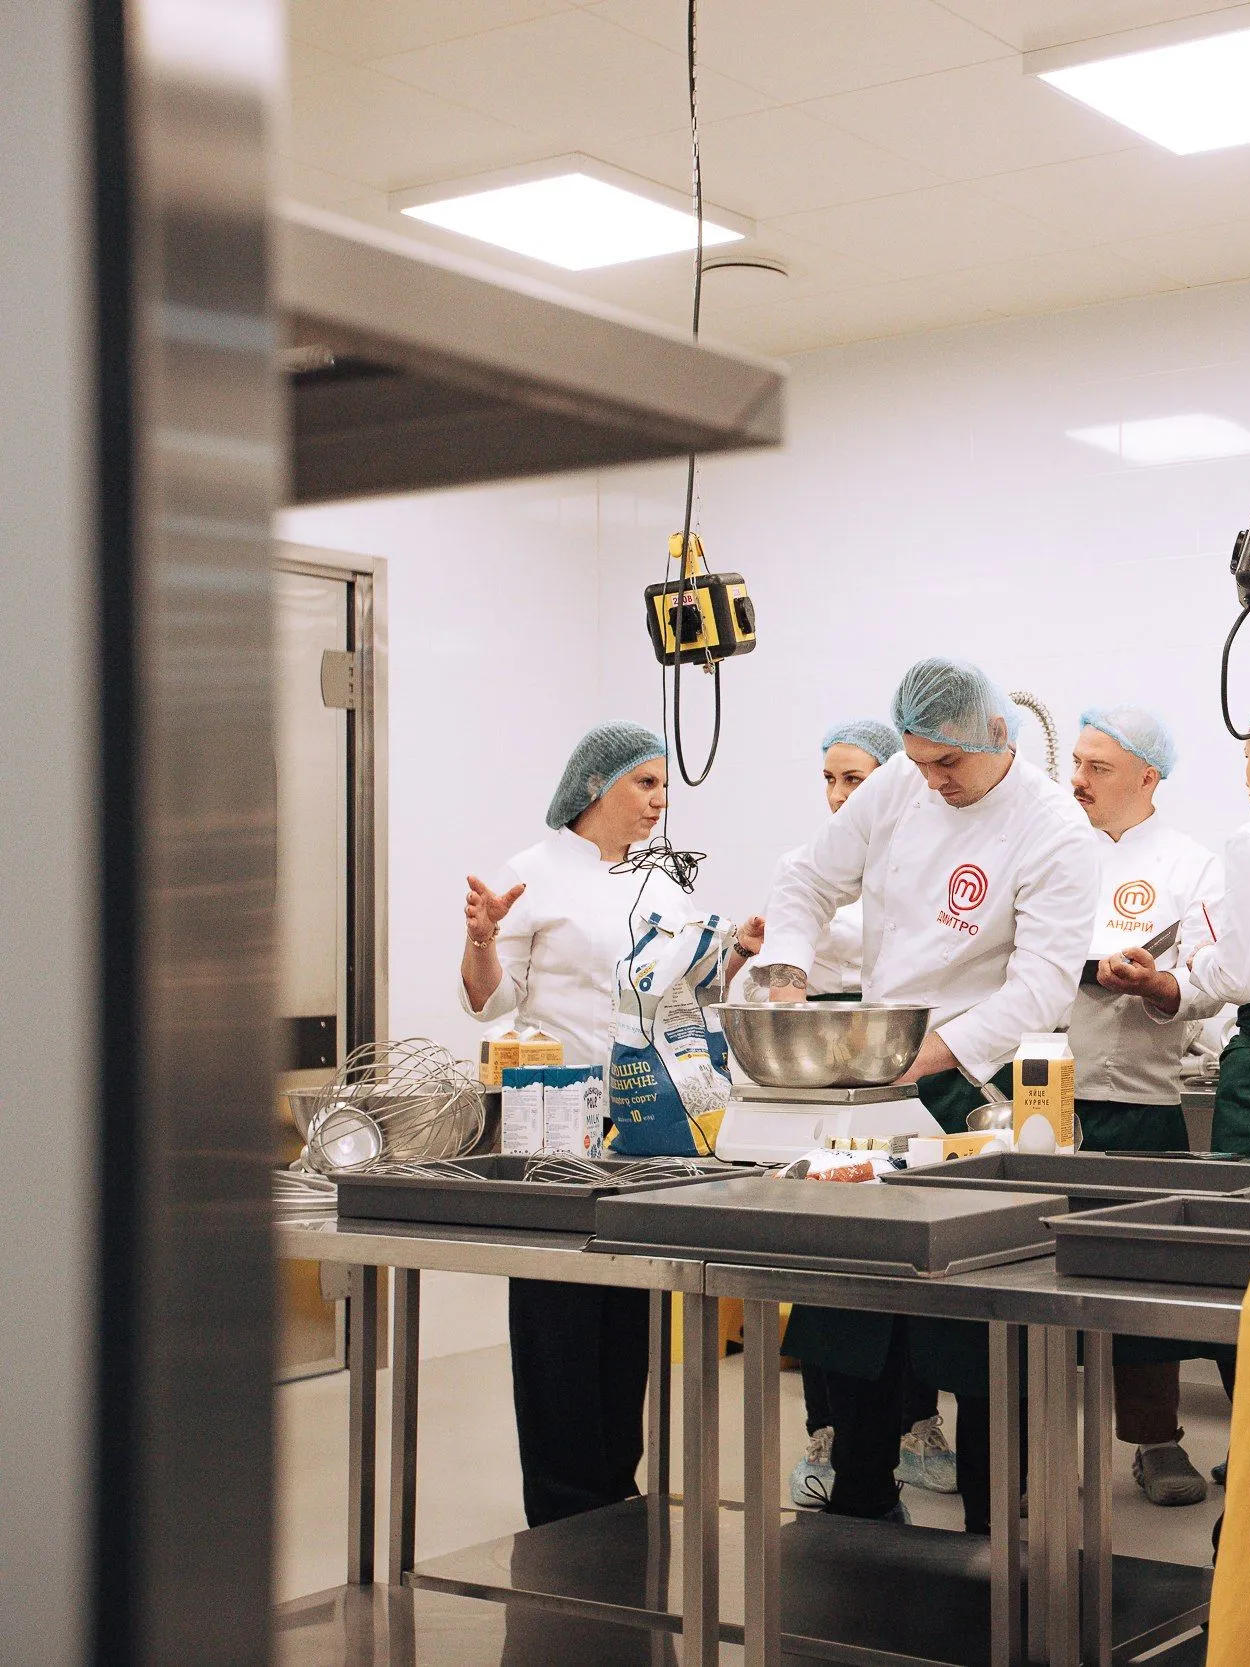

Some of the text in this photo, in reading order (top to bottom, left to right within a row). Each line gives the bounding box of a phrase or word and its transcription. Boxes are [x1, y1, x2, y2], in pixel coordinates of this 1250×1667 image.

[672, 595, 693, 605] 20В
[1106, 919, 1154, 933] АНДРІЙ
[1028, 1089, 1045, 1098] ЯЙЦЕ
[586, 1113, 600, 1125] MILK
[630, 1109, 642, 1122] 10
